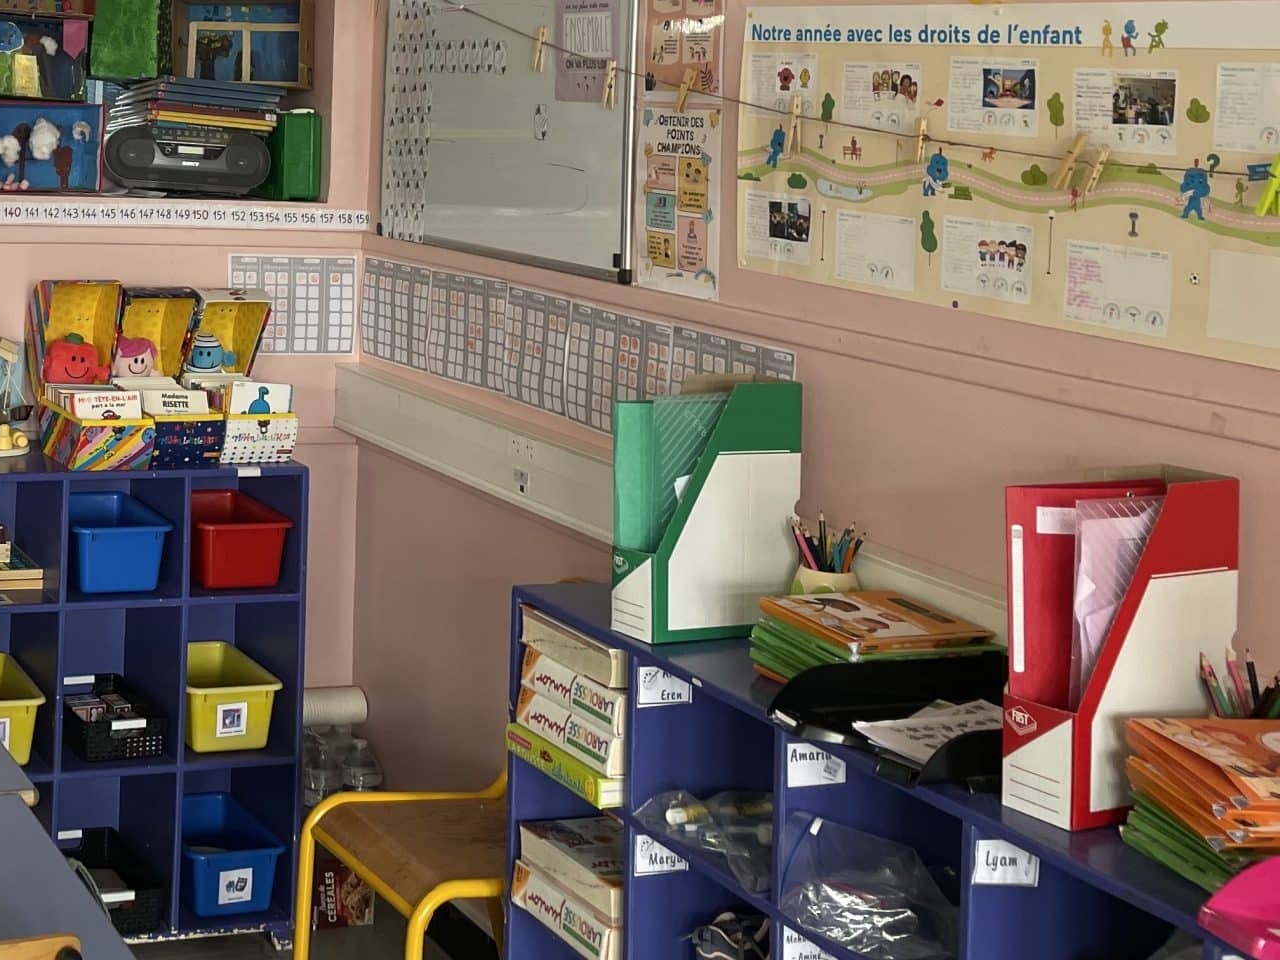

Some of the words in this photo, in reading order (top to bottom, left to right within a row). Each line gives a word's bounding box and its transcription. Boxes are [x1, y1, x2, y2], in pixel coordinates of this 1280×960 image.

[565, 15, 610, 52] ENSEMBLE
[752, 23, 791, 41] Notre
[796, 23, 842, 41] année
[847, 29, 882, 41] avec
[889, 24, 912, 42] les
[918, 24, 970, 43] droits
[977, 24, 1001, 43] de
[1008, 24, 1082, 44] l'enfant
[658, 115, 690, 128] OBTENIR
[691, 117, 704, 128] DES
[666, 129, 695, 141] POINTS
[657, 142, 701, 155] CHAMPIONS
[162, 400, 189, 408] RISETTE
[536, 673, 577, 704] junior
[573, 681, 615, 716] LAROUSSE
[660, 688, 683, 702] Eren
[530, 713, 572, 744] junior
[568, 721, 609, 756] LAROUSSE
[985, 850, 1018, 871] Lyam
[528, 892, 566, 928] junior
[564, 906, 601, 949] LAROUSSE
